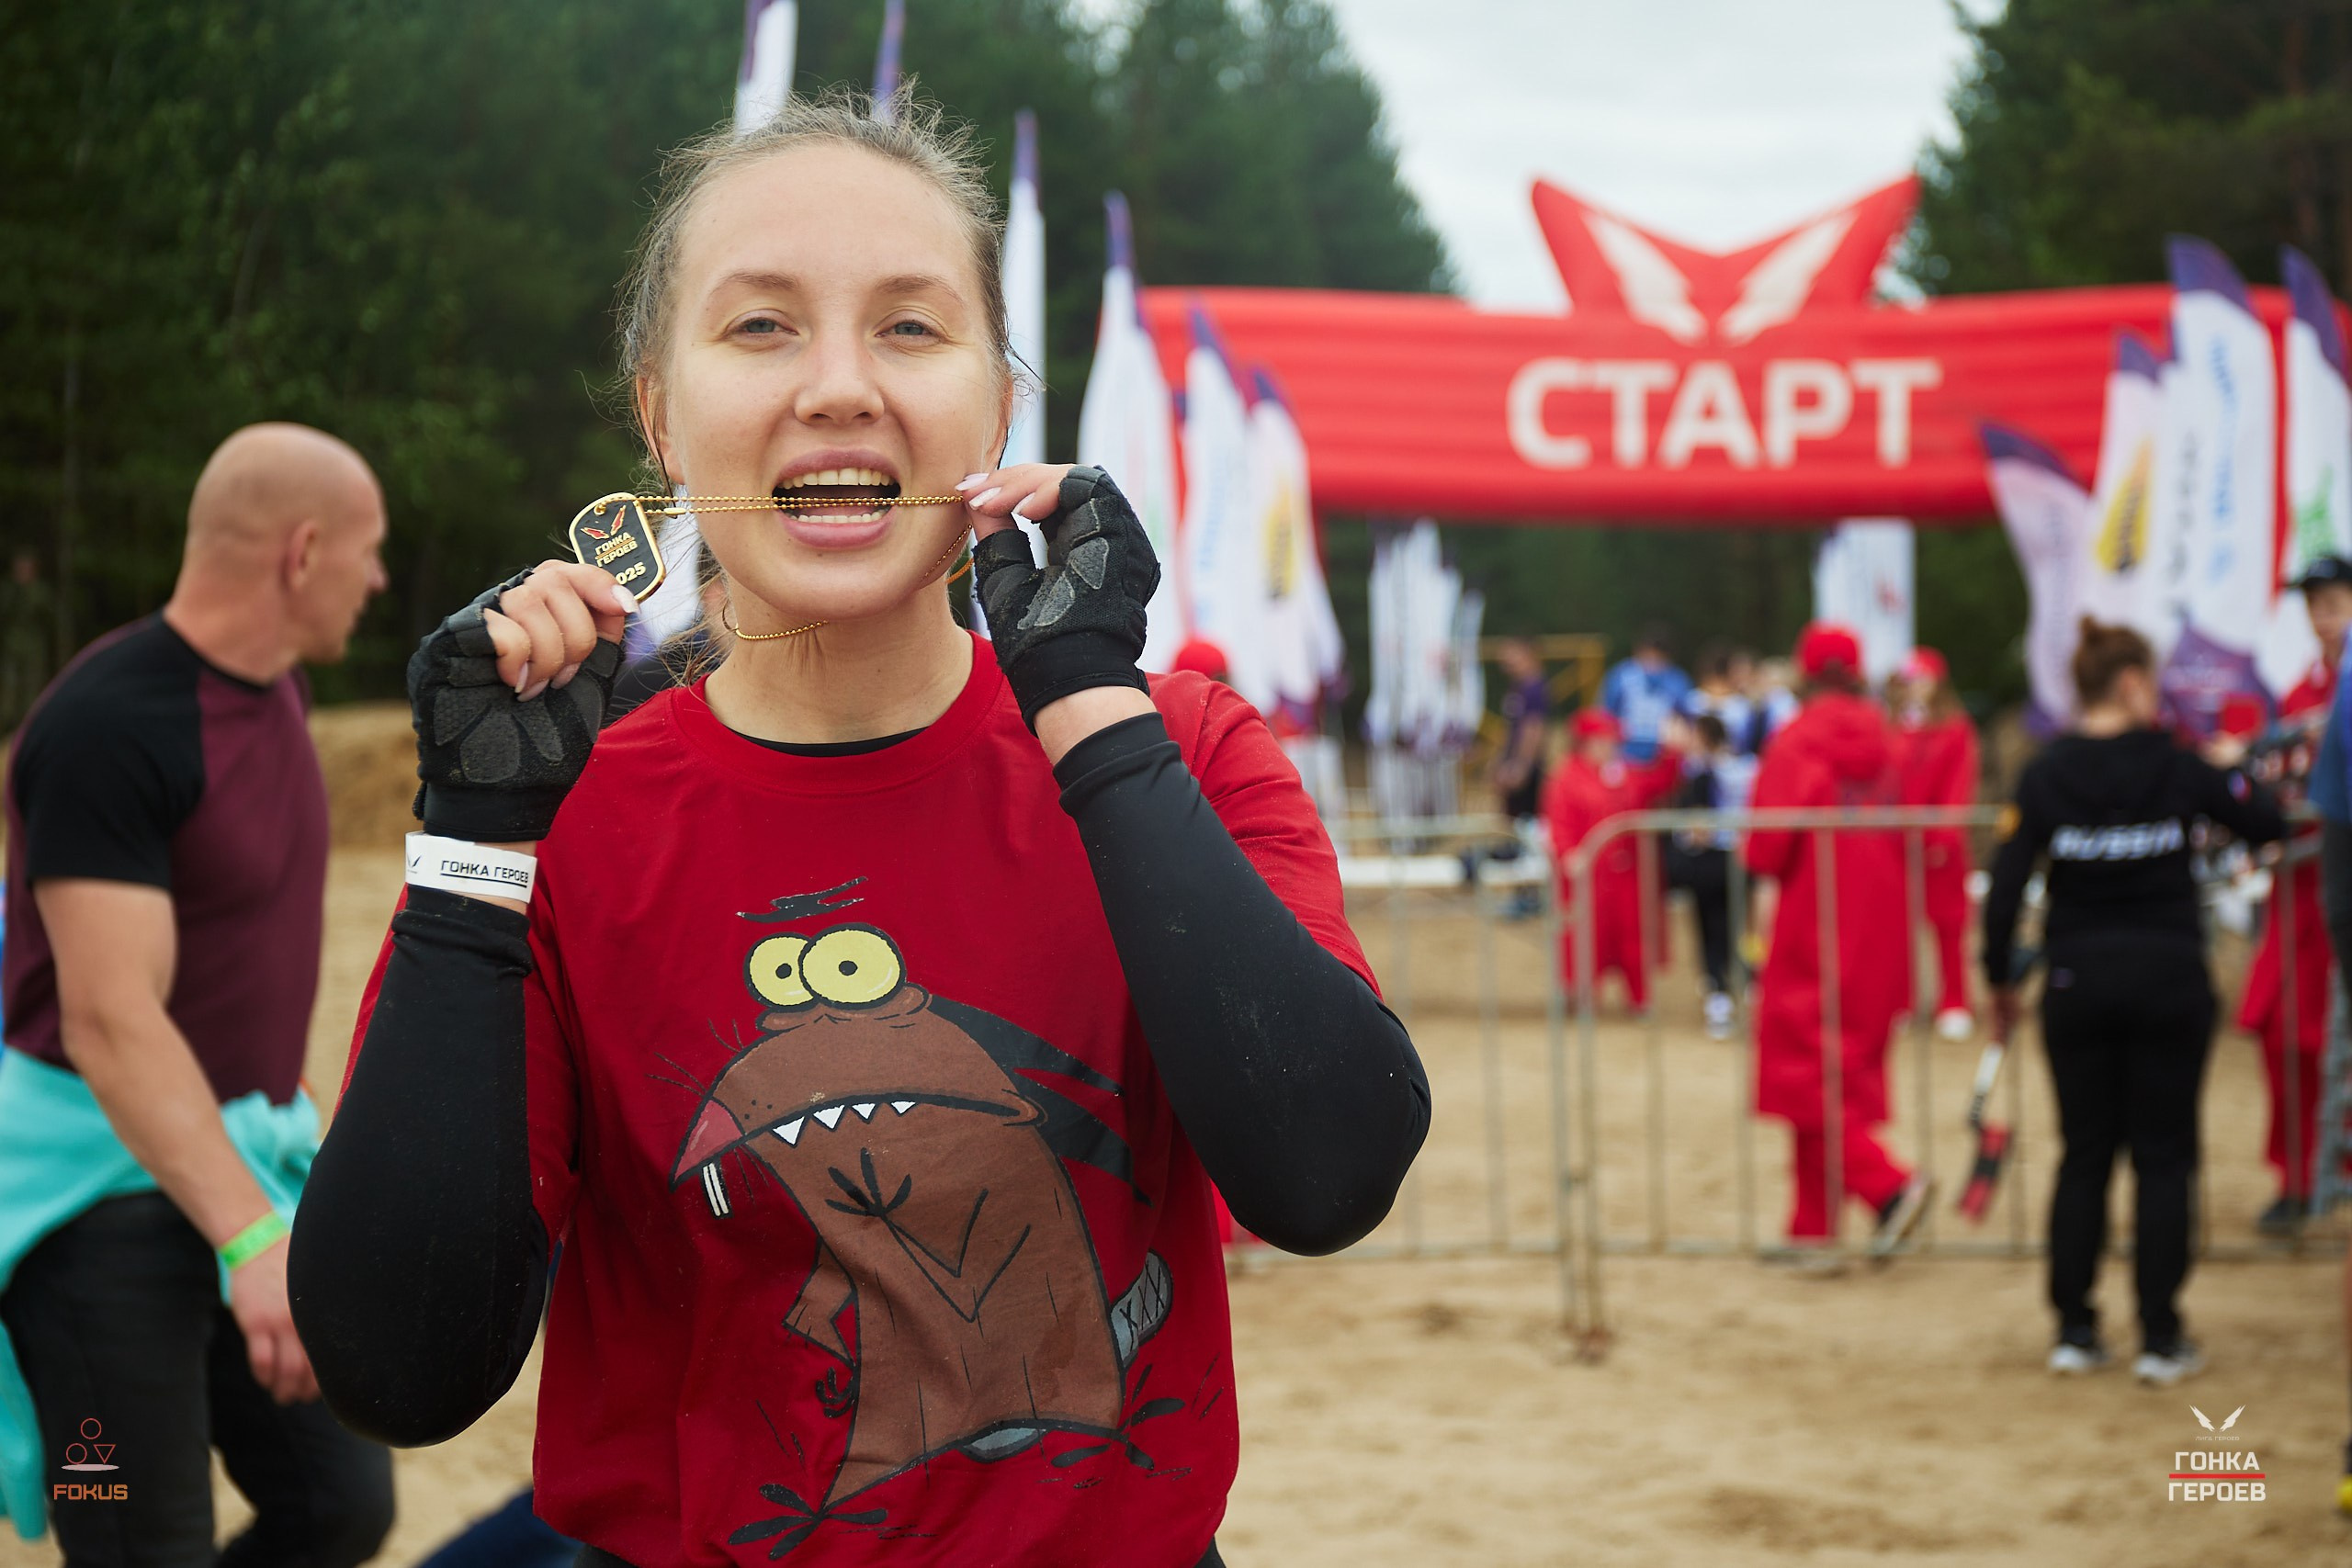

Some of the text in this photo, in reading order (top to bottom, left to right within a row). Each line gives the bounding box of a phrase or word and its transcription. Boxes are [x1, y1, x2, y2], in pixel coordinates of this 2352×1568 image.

[1507, 356, 1944, 471] СТАРТ
[594, 532, 632, 556] ГОНКА
[596, 540, 639, 568] ГЕРОЕВ
[615, 561, 647, 585] 025
[441, 860, 529, 884] ГОНКА ГЕРОЕВ
